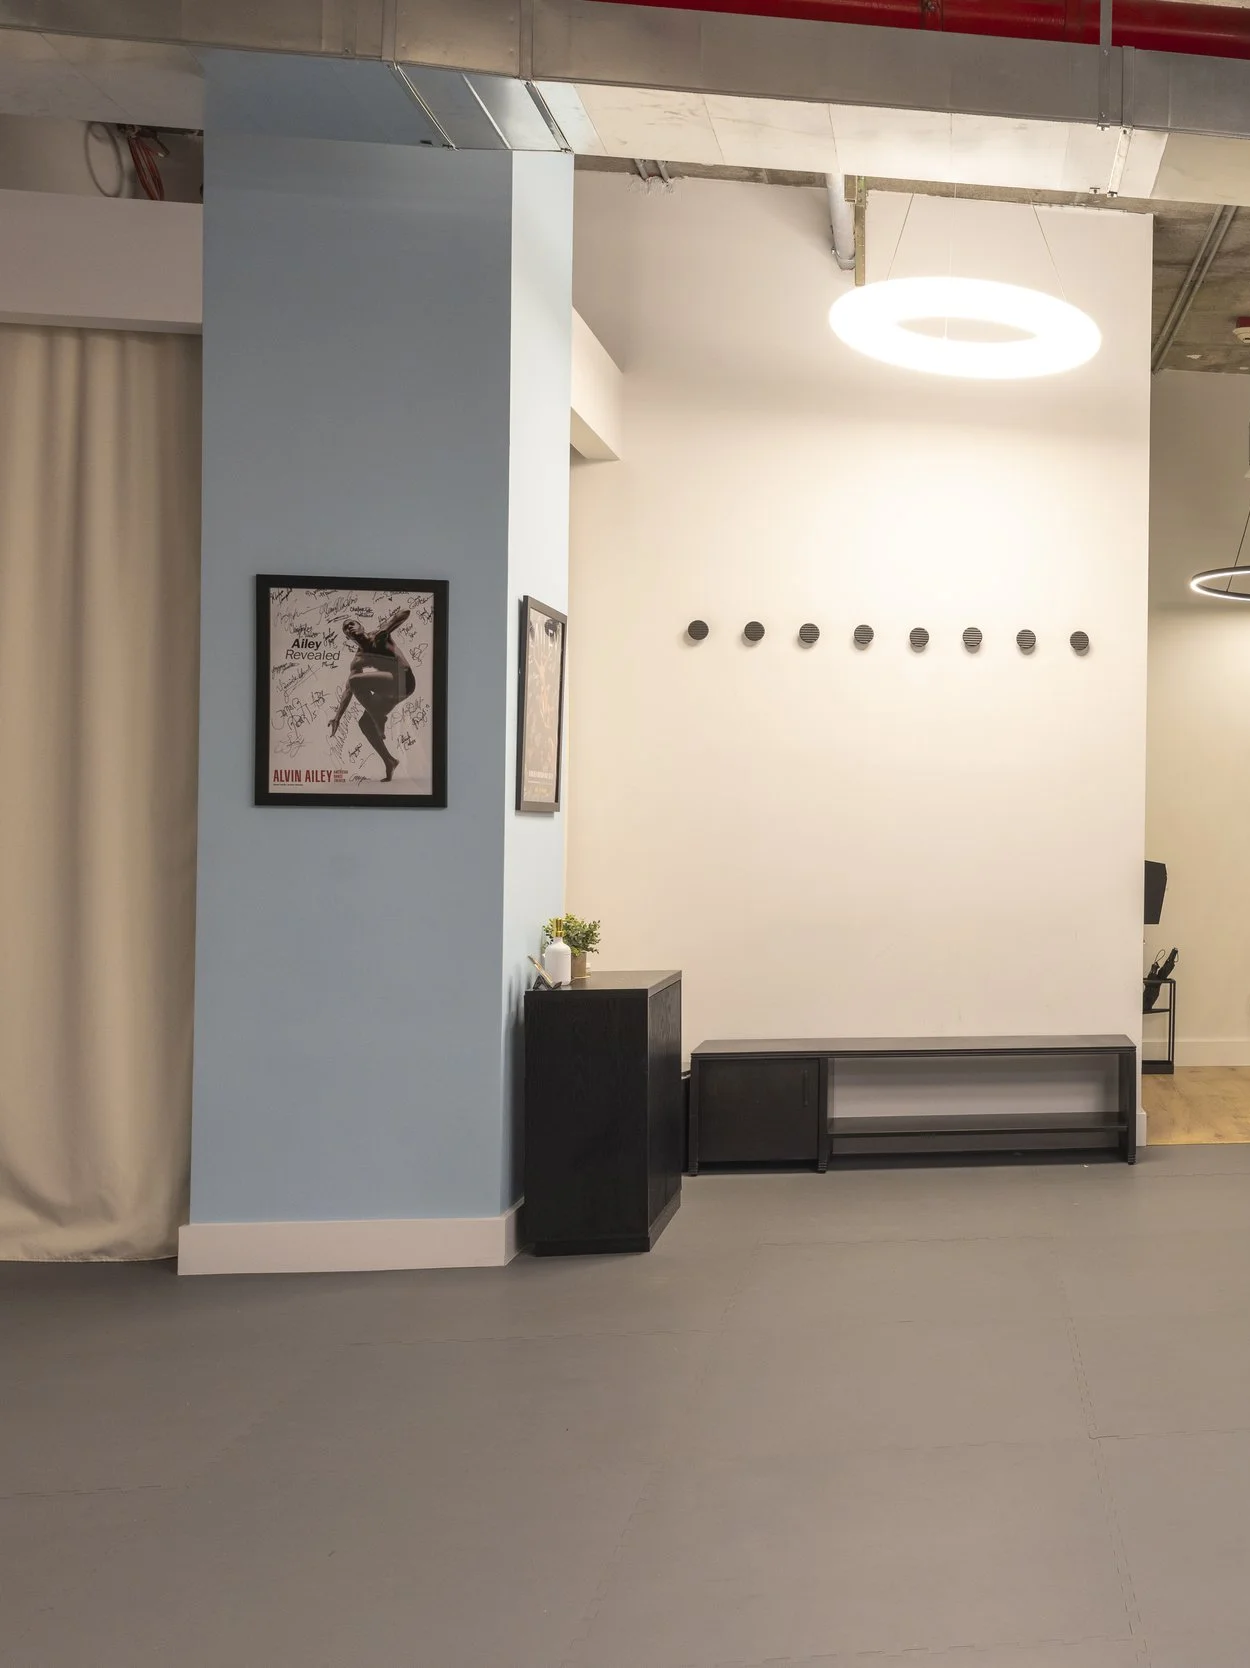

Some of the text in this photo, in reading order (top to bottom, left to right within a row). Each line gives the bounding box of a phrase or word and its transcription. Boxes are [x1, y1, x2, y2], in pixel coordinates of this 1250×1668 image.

[291, 638, 322, 651] Ailey
[285, 649, 341, 661] Revealed
[273, 769, 302, 783] ALVIN
[304, 769, 333, 783] AILEY
